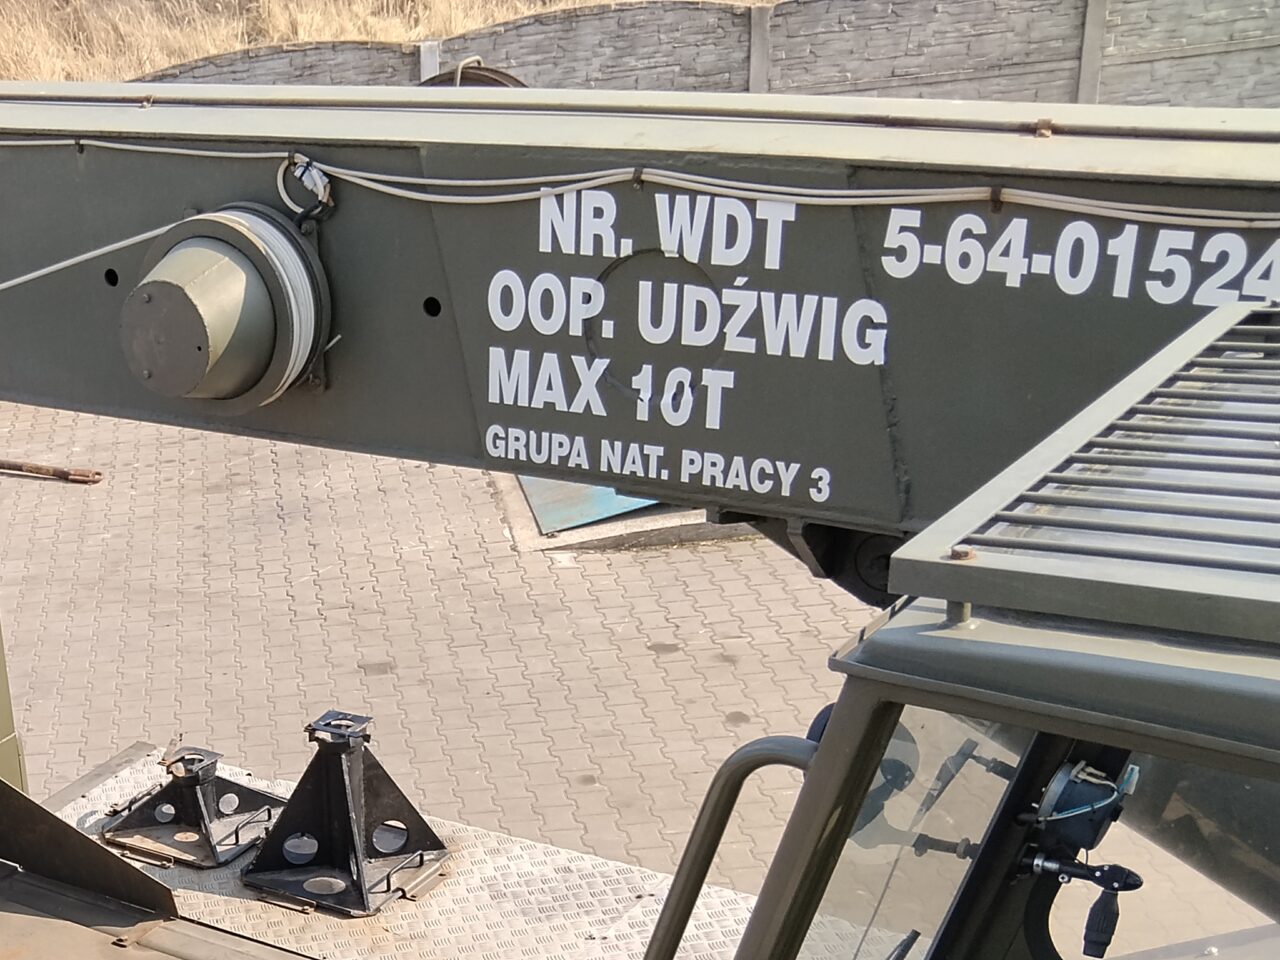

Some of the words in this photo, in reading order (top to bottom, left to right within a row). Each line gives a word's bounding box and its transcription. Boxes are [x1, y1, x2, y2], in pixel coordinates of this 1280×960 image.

[538, 187, 633, 258] NR.
[655, 193, 796, 270] WDT
[880, 207, 1280, 309] 5-64-01524
[487, 269, 615, 339] OOP.
[637, 276, 888, 366] UDŹWIG
[488, 346, 611, 417] MAX
[631, 363, 735, 430] 10T
[485, 424, 590, 470] GRUPA
[599, 439, 669, 481] NAT.
[680, 449, 801, 497] PRACY
[808, 467, 831, 503] 3
